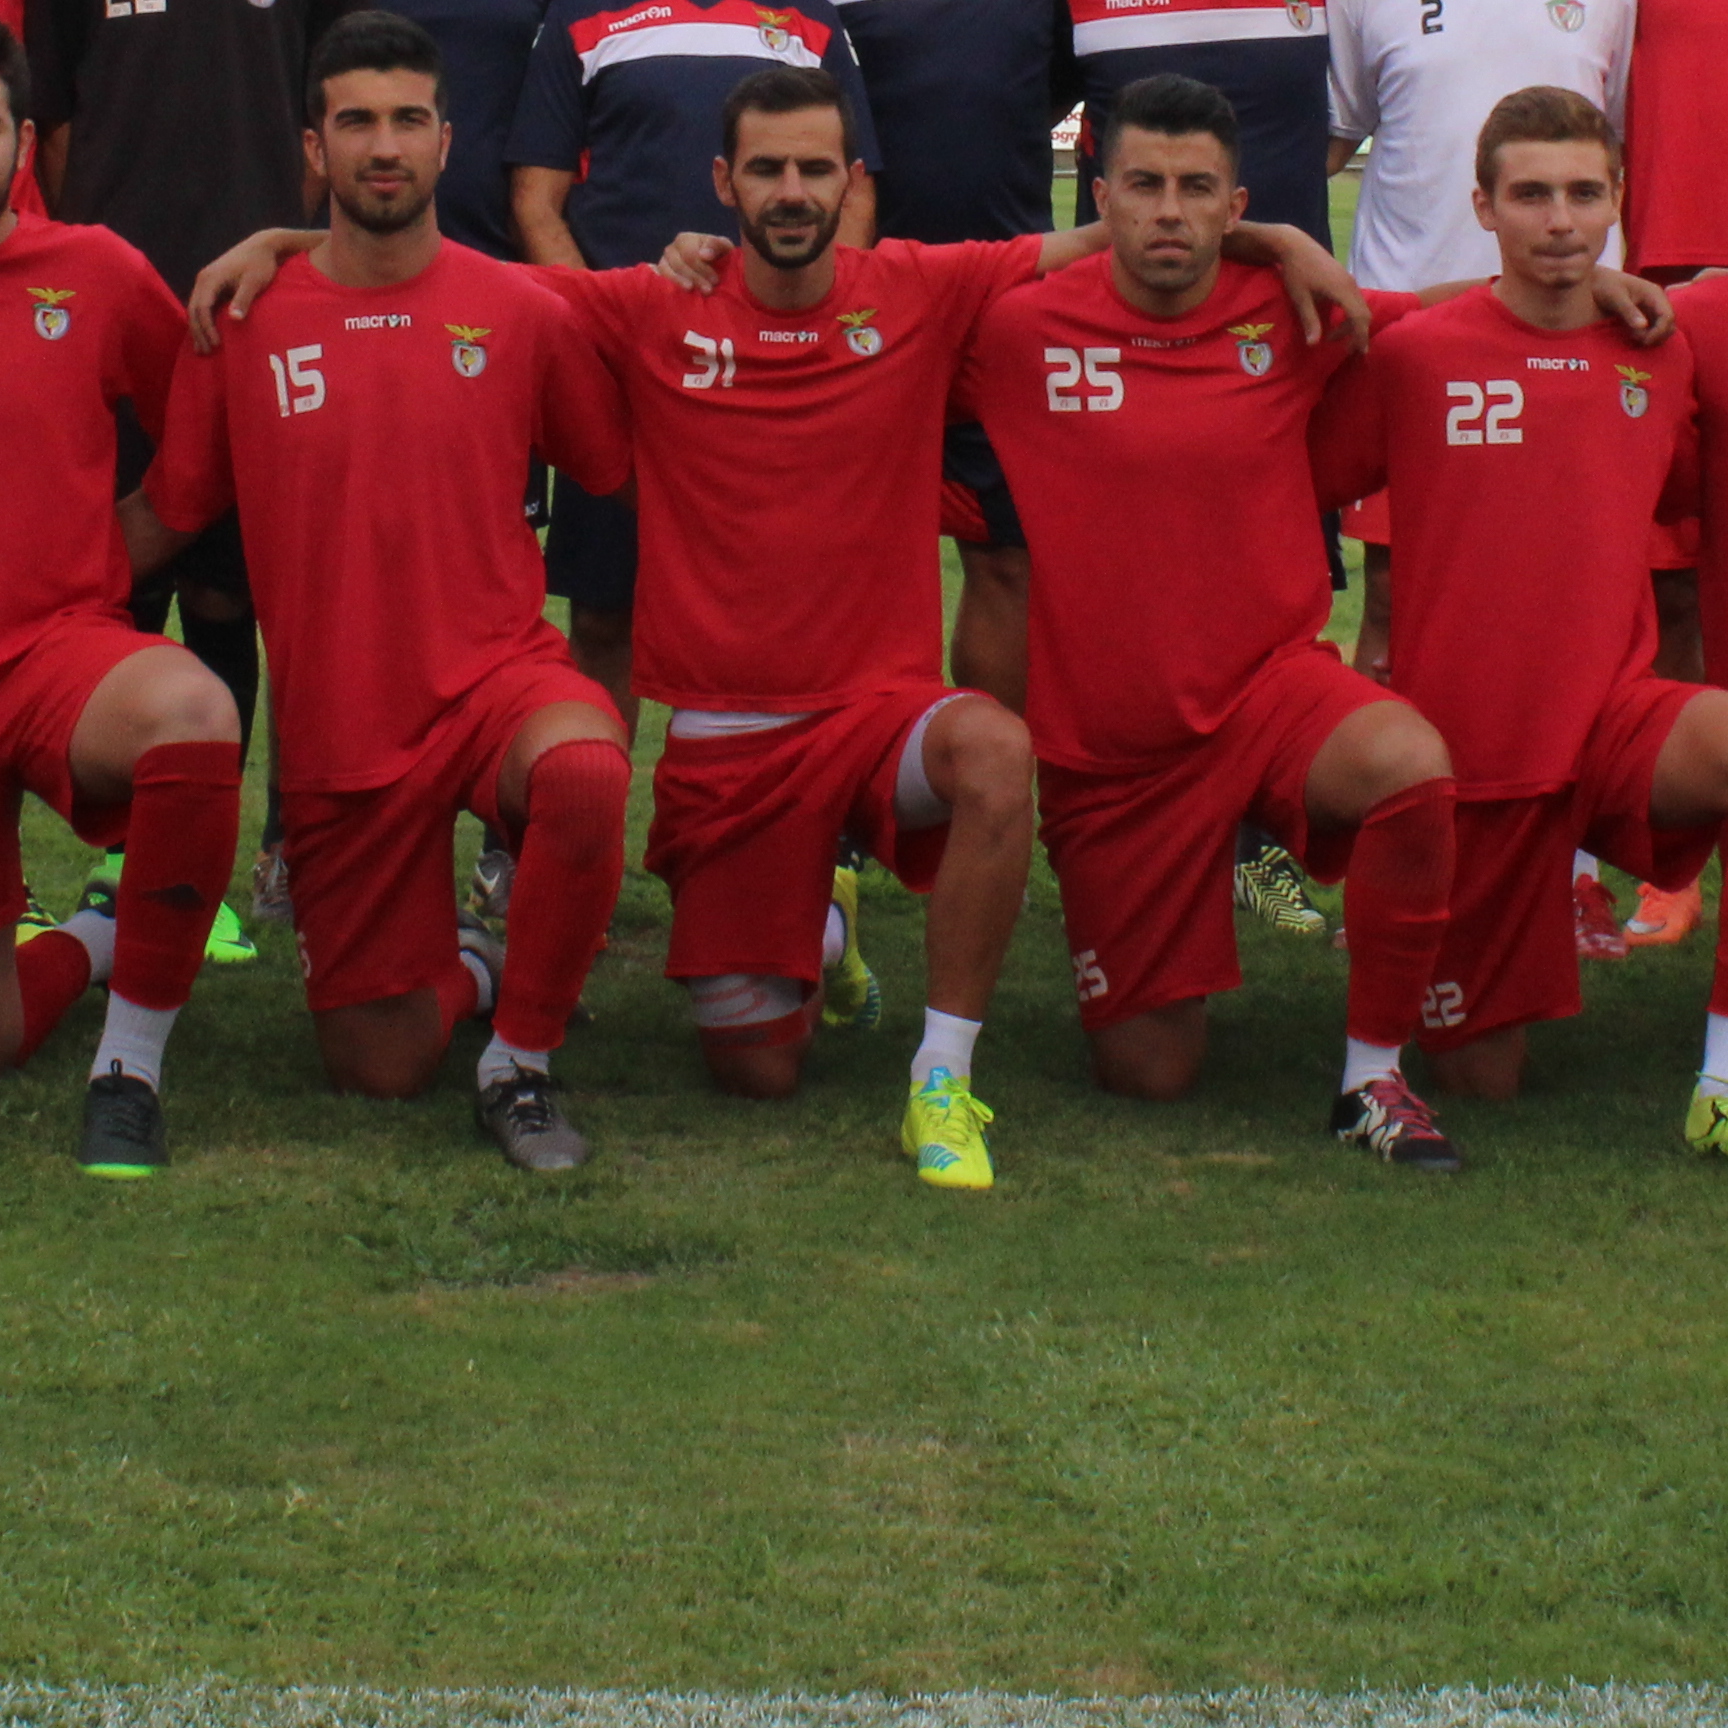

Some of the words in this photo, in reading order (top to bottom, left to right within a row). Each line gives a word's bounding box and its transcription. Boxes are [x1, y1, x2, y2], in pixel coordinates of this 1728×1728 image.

[608, 4, 672, 33] macron
[345, 315, 411, 330] macron
[759, 331, 818, 343] macron
[269, 344, 325, 417] 15
[683, 330, 735, 388] 31
[1045, 348, 1124, 411] 25
[1527, 358, 1589, 370] macron
[1447, 380, 1524, 445] 22
[1421, 981, 1467, 1028] 22
